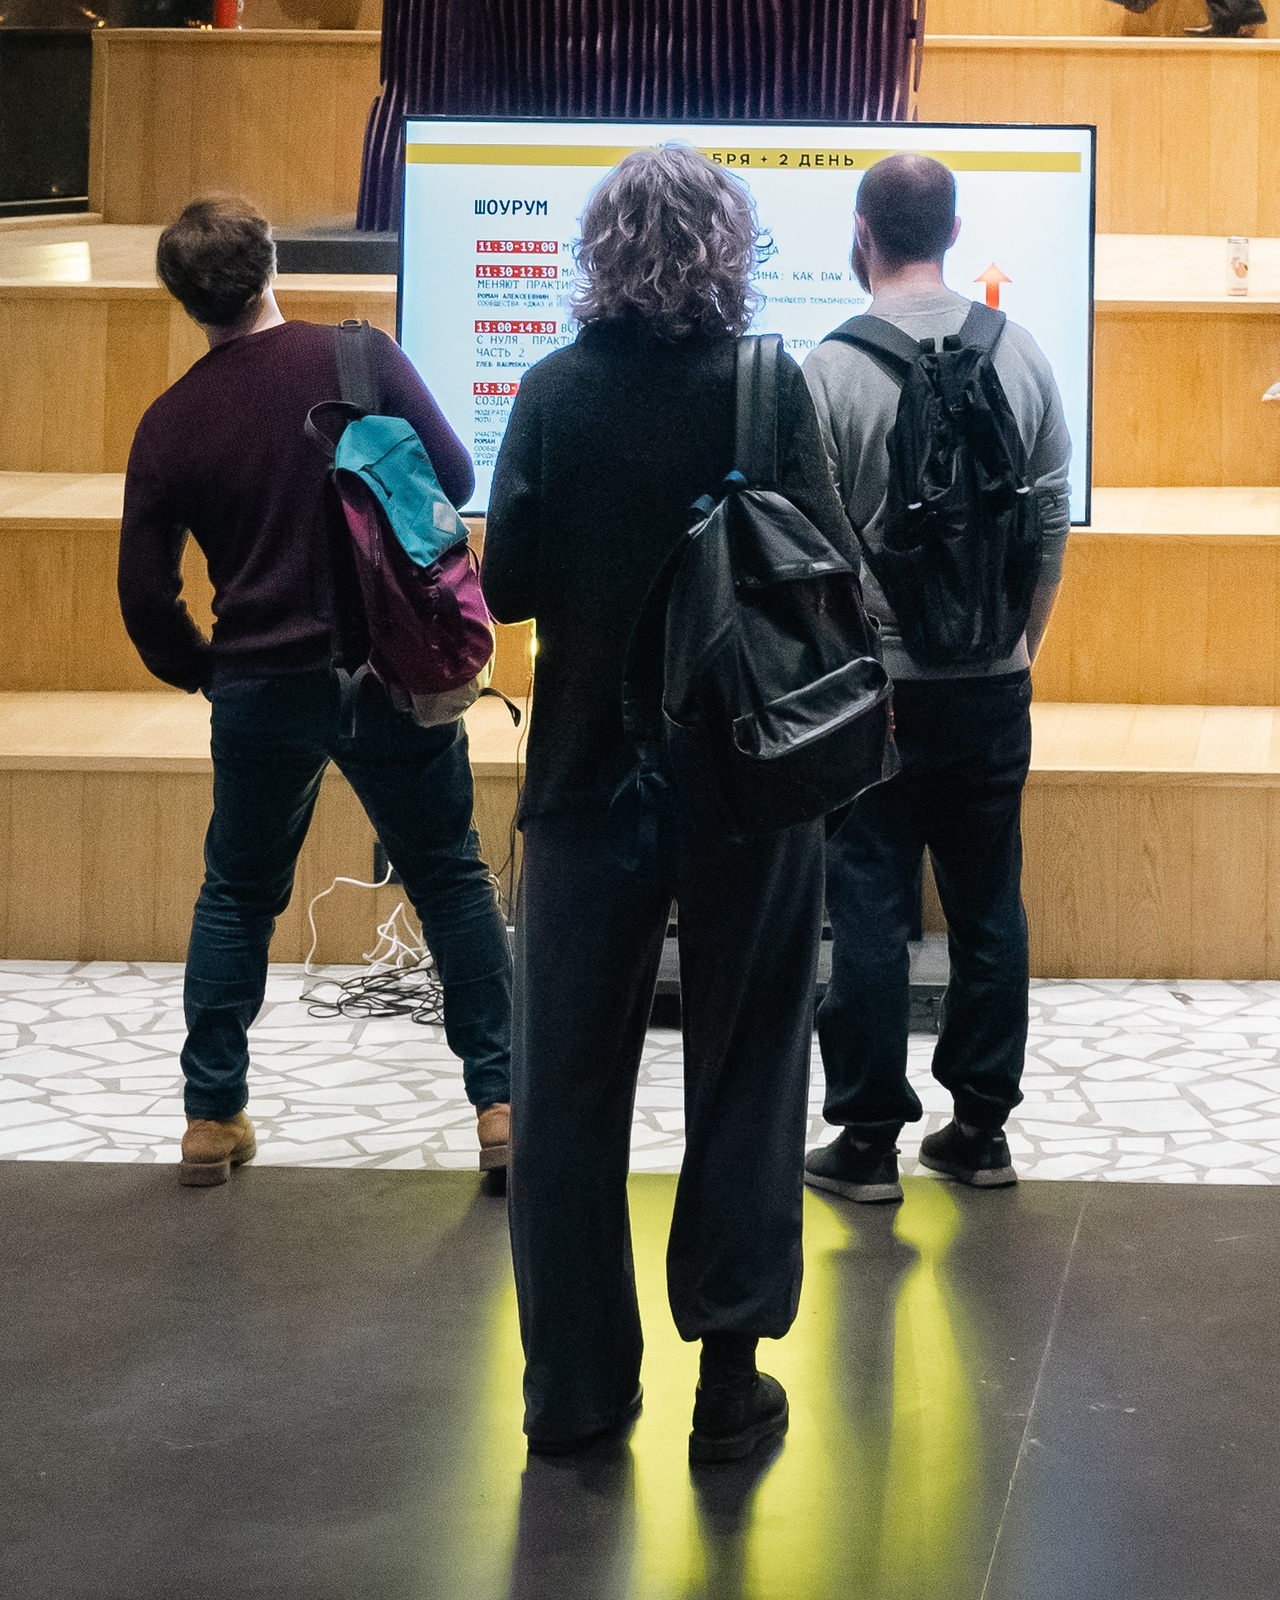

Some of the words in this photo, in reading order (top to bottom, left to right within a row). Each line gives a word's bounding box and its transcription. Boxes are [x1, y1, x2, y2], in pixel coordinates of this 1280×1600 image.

[708, 153, 750, 166] БРЯ
[779, 154, 788, 165] 2
[799, 154, 854, 167] ДЕНЬ
[474, 199, 548, 216] ШОУРУМ
[478, 241, 556, 252] 11:30-19:00
[478, 266, 555, 278] 11:30-12:30
[792, 271, 814, 281] КАК
[821, 271, 843, 281] DAW
[477, 280, 520, 289] МЕНЯЮТ
[477, 322, 554, 333] 13:00-14:30
[476, 336, 484, 344] С
[476, 348, 511, 357] ЧАСТЬ
[519, 348, 525, 357] 2
[475, 383, 516, 394] 15:30-
